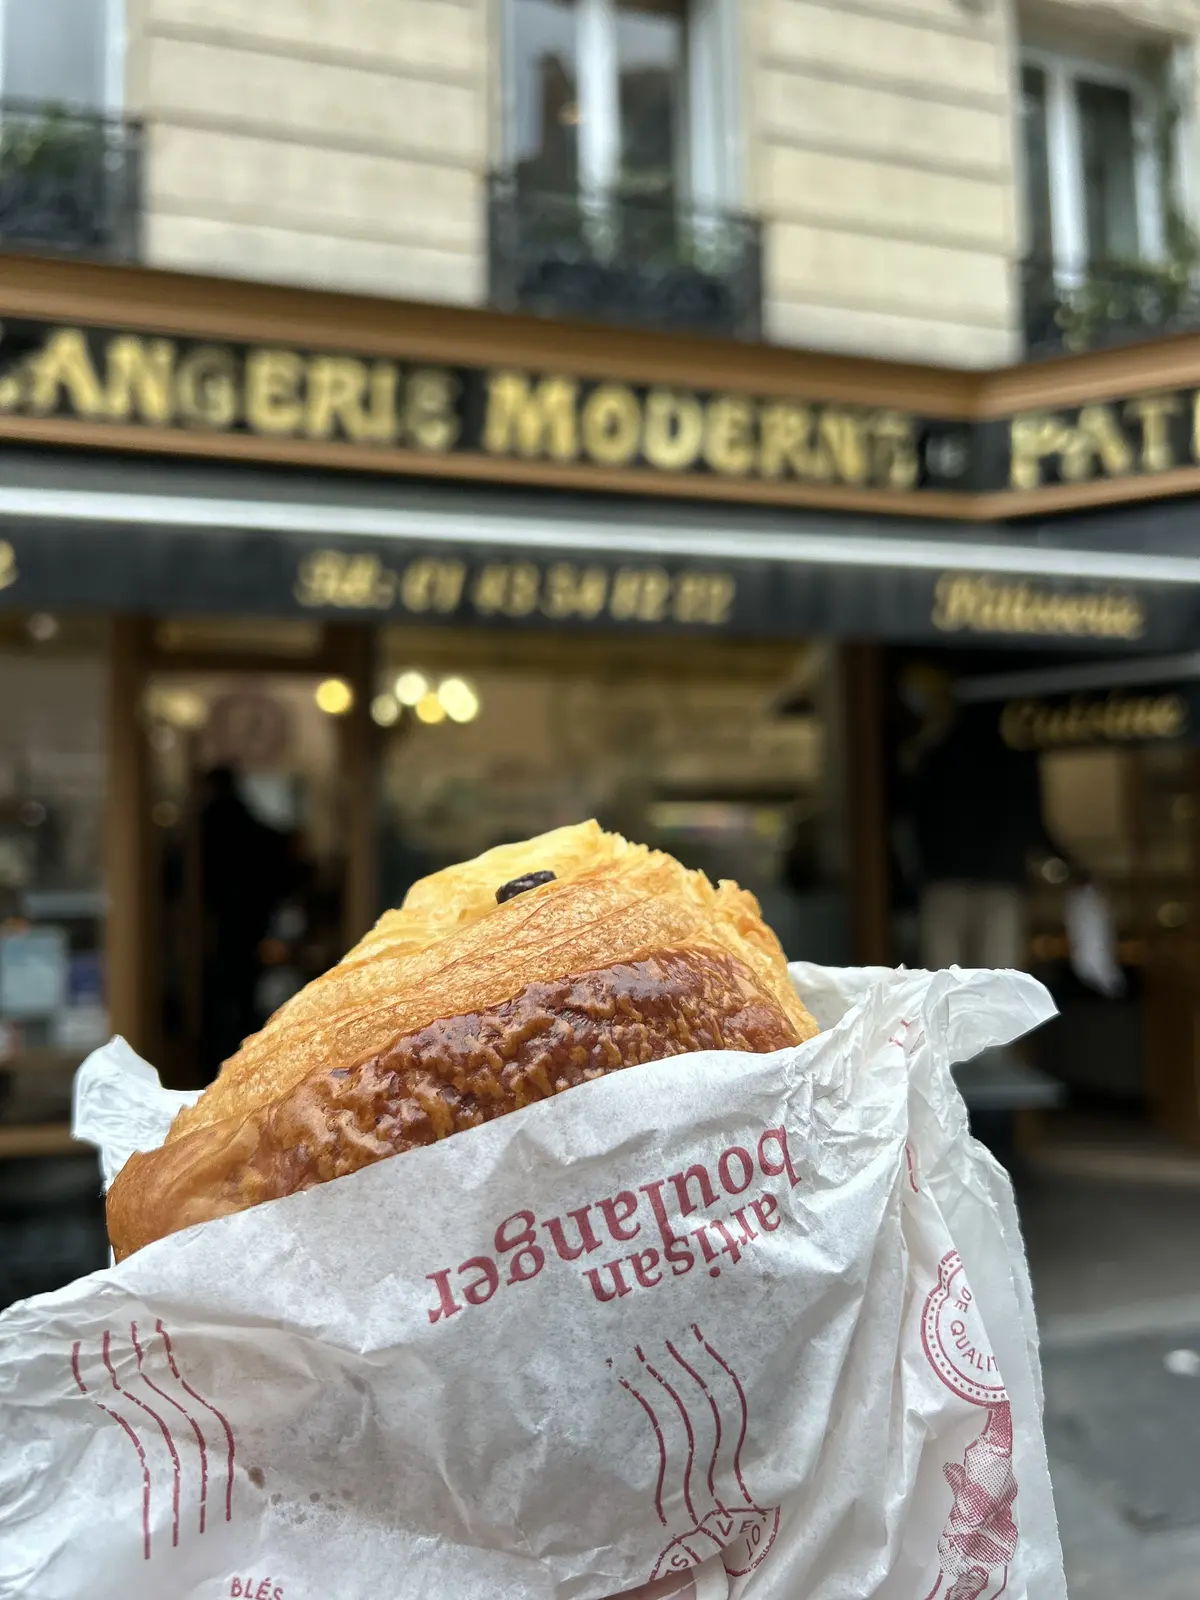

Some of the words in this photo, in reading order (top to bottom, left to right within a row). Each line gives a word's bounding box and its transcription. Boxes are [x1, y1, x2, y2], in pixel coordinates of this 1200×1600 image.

[484, 367, 920, 488] MODERNE
[425, 1124, 802, 1324] boulanger
[582, 1193, 782, 1302] artisan
[954, 1285, 972, 1313] DE
[231, 1576, 284, 1600] BLÉS
